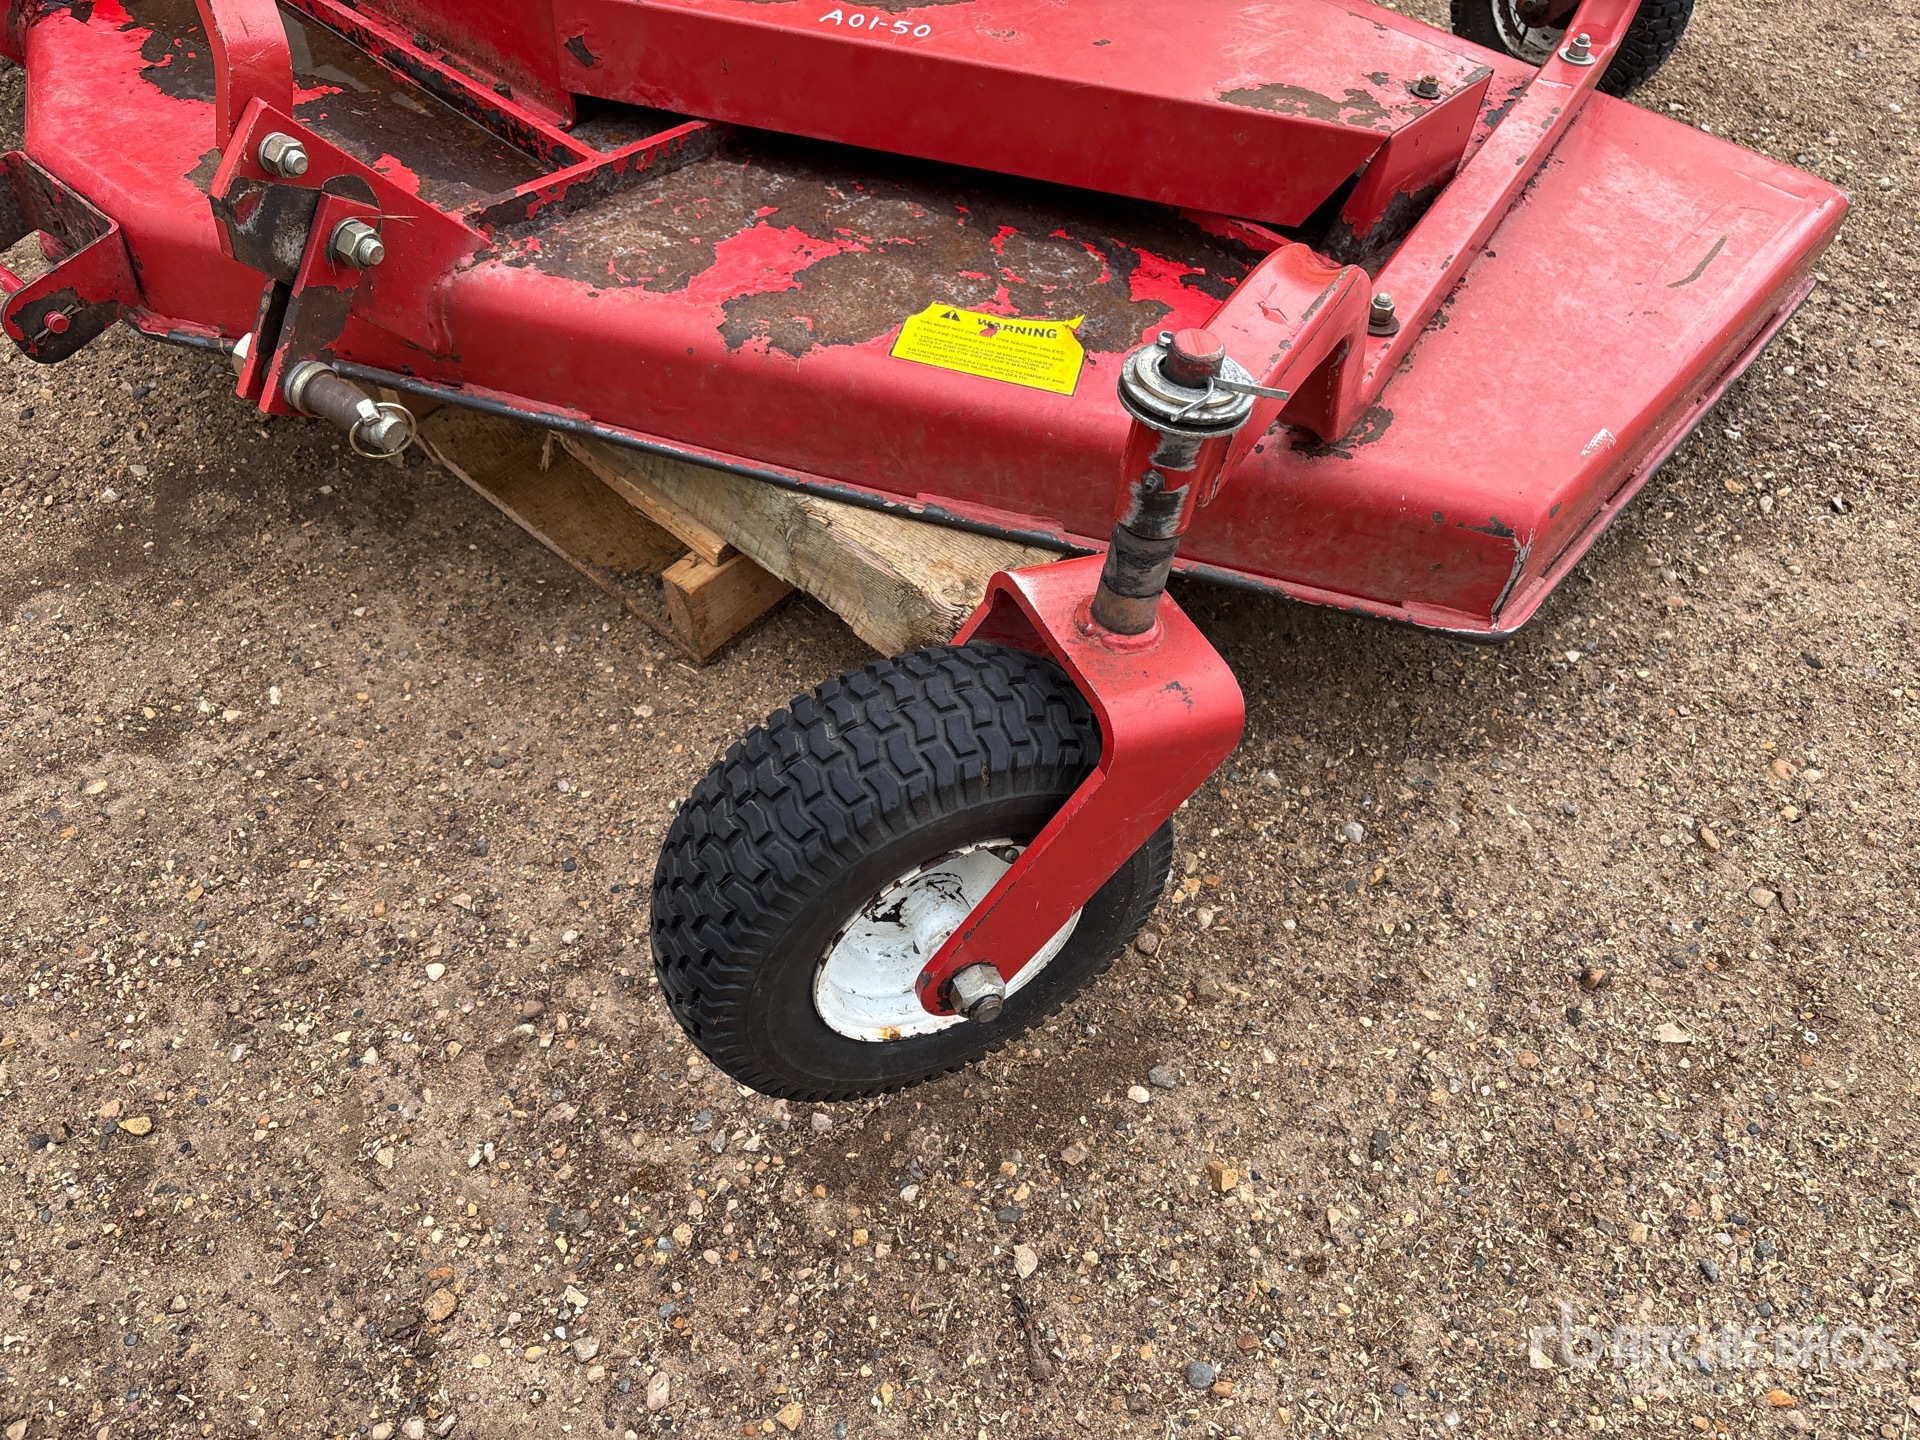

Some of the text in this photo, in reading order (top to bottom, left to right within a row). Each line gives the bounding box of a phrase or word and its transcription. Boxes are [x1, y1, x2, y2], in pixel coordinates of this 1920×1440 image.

[818, 9, 931, 37] A01-50
[977, 318, 1057, 339] WARNING
[917, 341, 948, 352] OUTLINED
[934, 337, 953, 345] KNOW
[951, 334, 978, 343] TRAINED
[997, 343, 1013, 351] SAFE
[1014, 348, 1050, 360] OPERATION
[1010, 340, 1039, 350] MACHINE
[906, 351, 931, 359] OTHERS
[942, 358, 970, 368] SERIOUS
[970, 364, 993, 374] INJURY
[918, 338, 942, 346] SAFETY
[957, 346, 993, 357] OPERATING
[994, 354, 1040, 368] INSTRUCTIONS
[917, 349, 954, 360] UNTRAINED
[954, 357, 989, 368] OPERATOR
[990, 365, 1023, 375] SUBJECTS
[1023, 372, 1051, 382] HIMSELF
